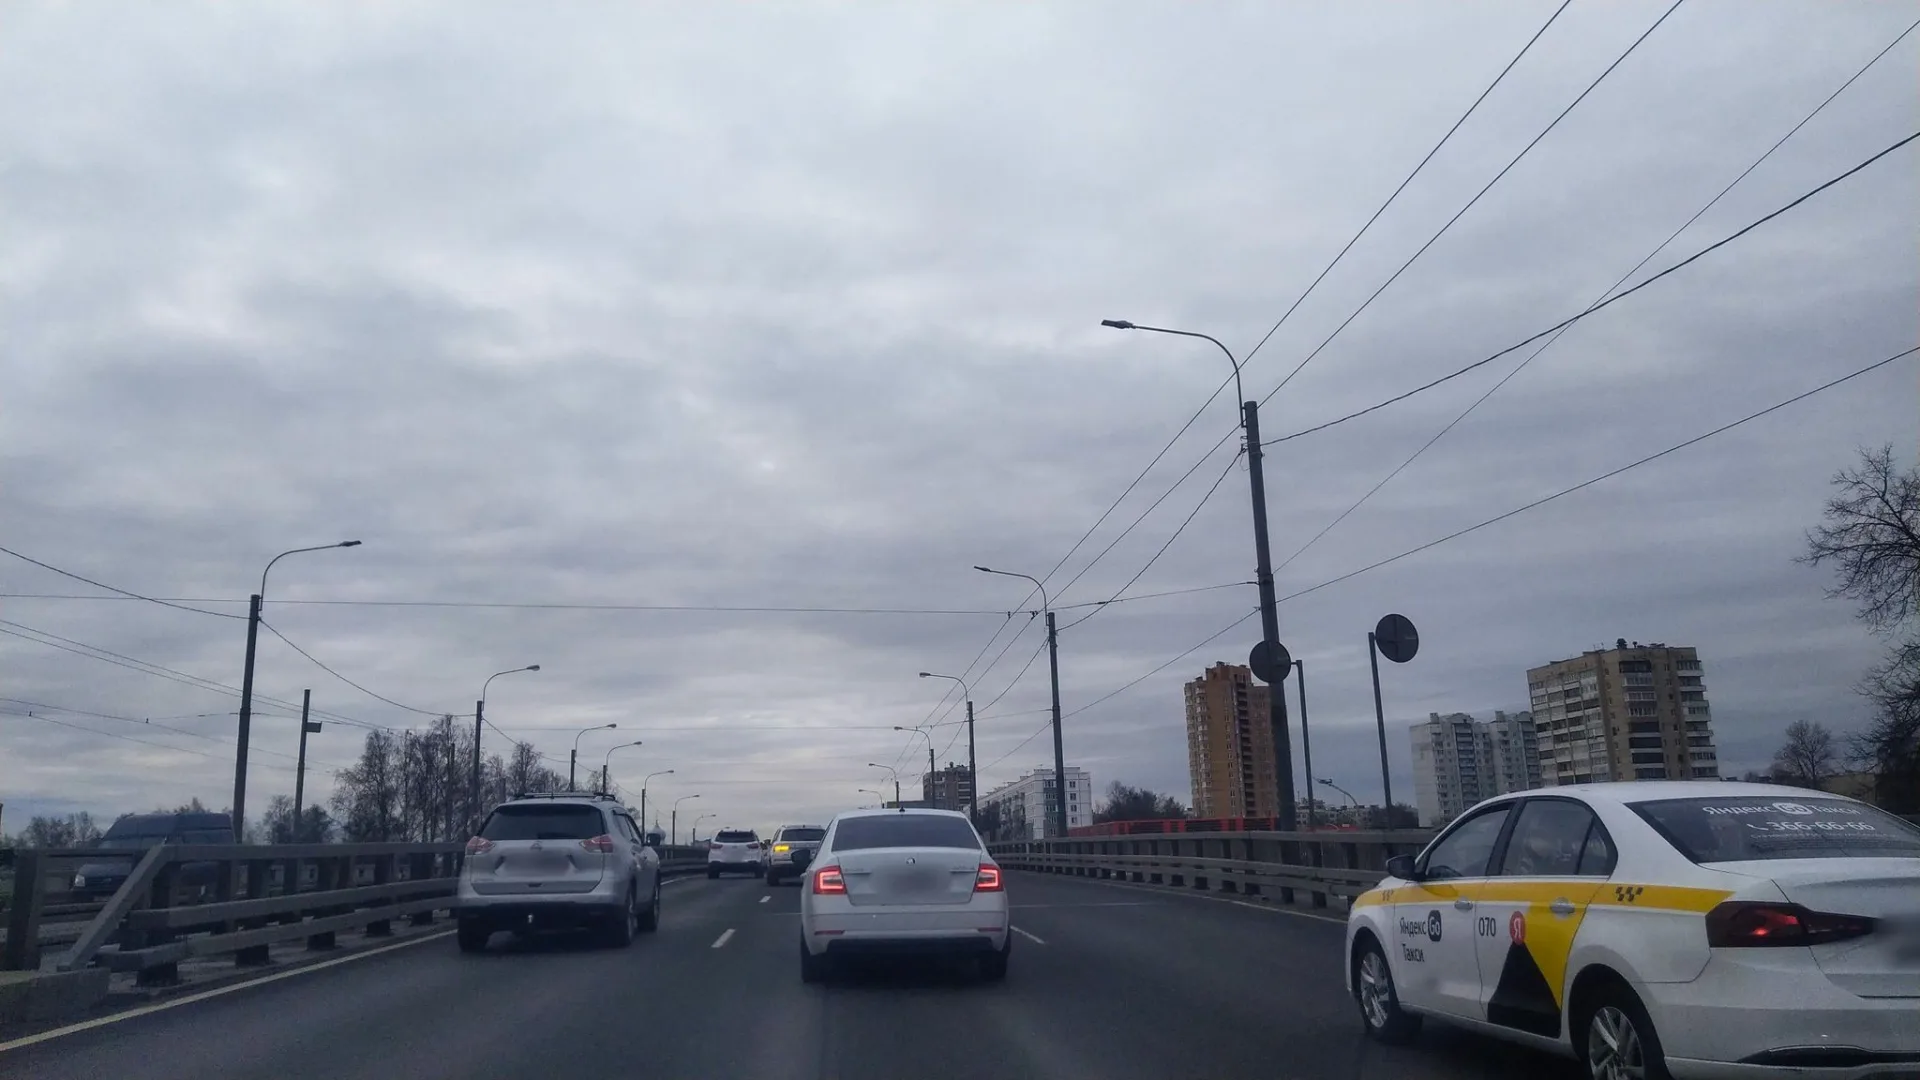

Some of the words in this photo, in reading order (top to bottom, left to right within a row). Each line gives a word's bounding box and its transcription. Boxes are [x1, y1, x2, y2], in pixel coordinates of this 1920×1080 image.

[1702, 806, 1777, 815] Яндекс
[1400, 917, 1426, 937] Яндекс
[1429, 914, 1441, 937] Go
[1478, 916, 1497, 937] 070
[1402, 943, 1425, 962] Такси
